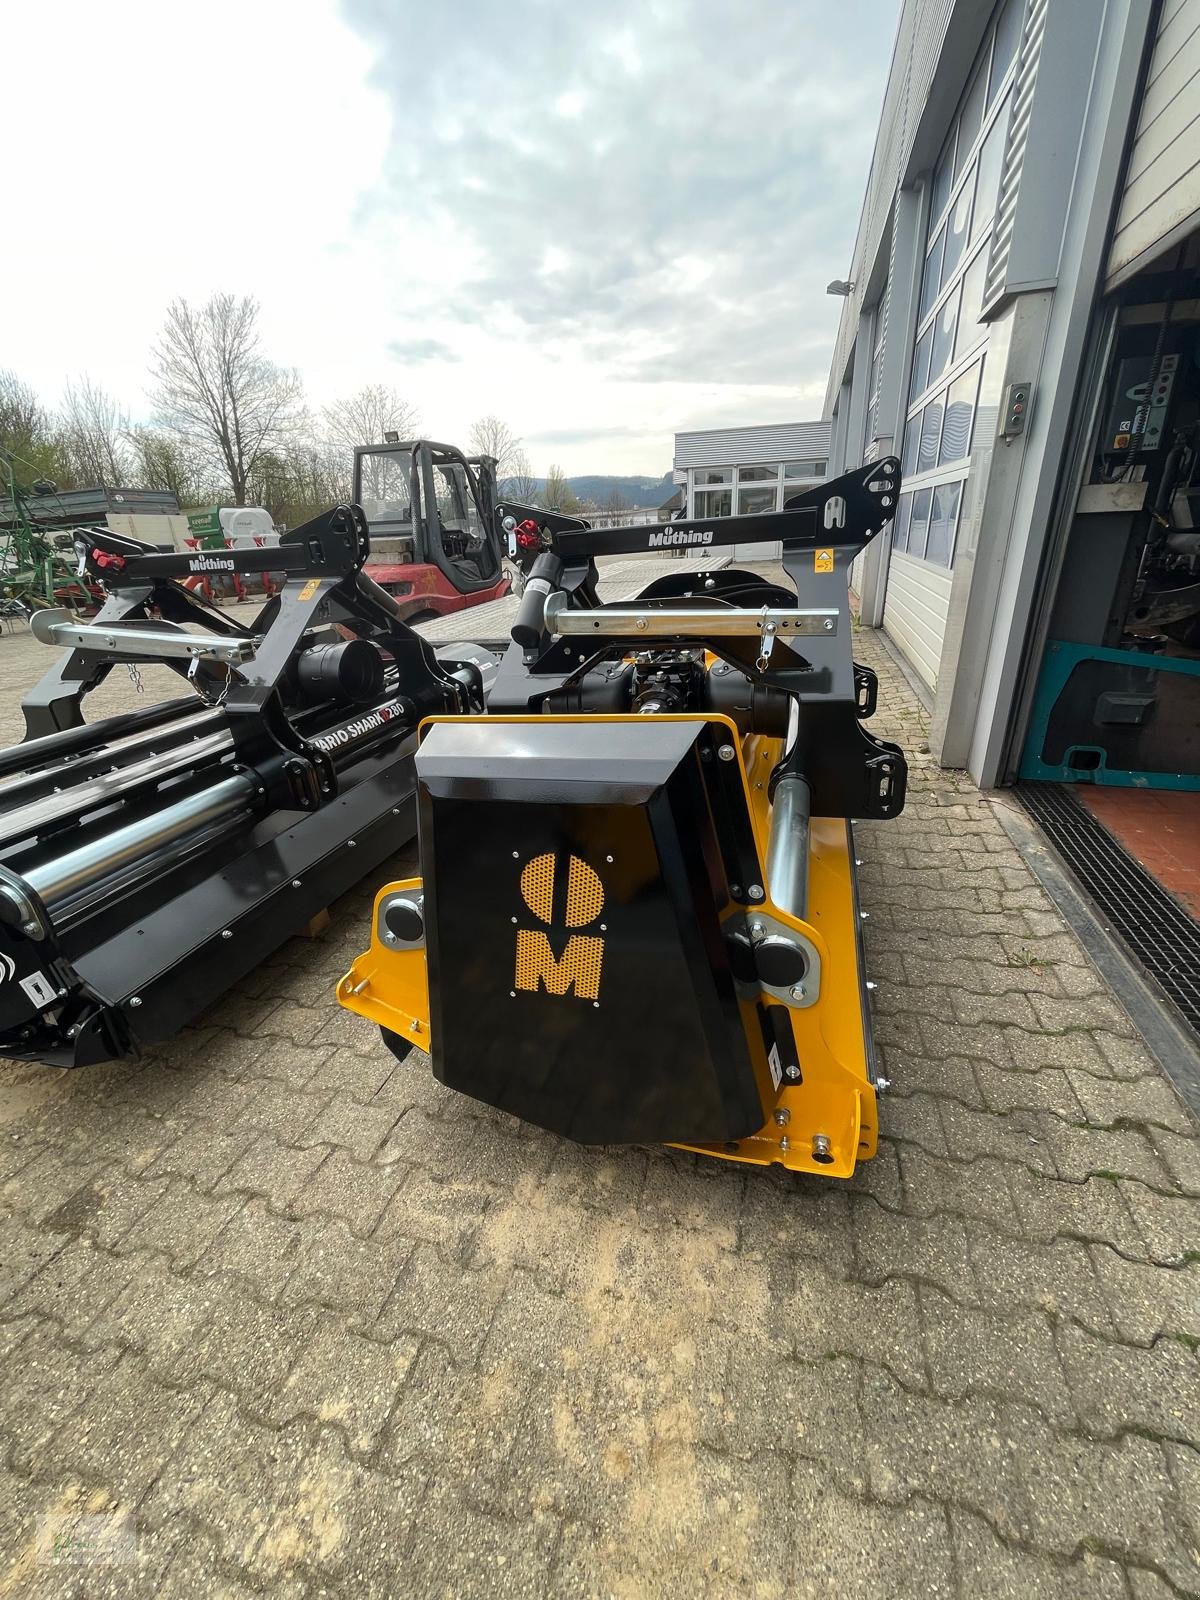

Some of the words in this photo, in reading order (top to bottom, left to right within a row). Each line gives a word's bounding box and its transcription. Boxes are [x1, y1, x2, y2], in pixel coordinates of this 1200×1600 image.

[648, 526, 714, 547] Müthing
[189, 554, 235, 571] Müthing
[347, 712, 386, 738] SHARK
[385, 702, 405, 720] 280
